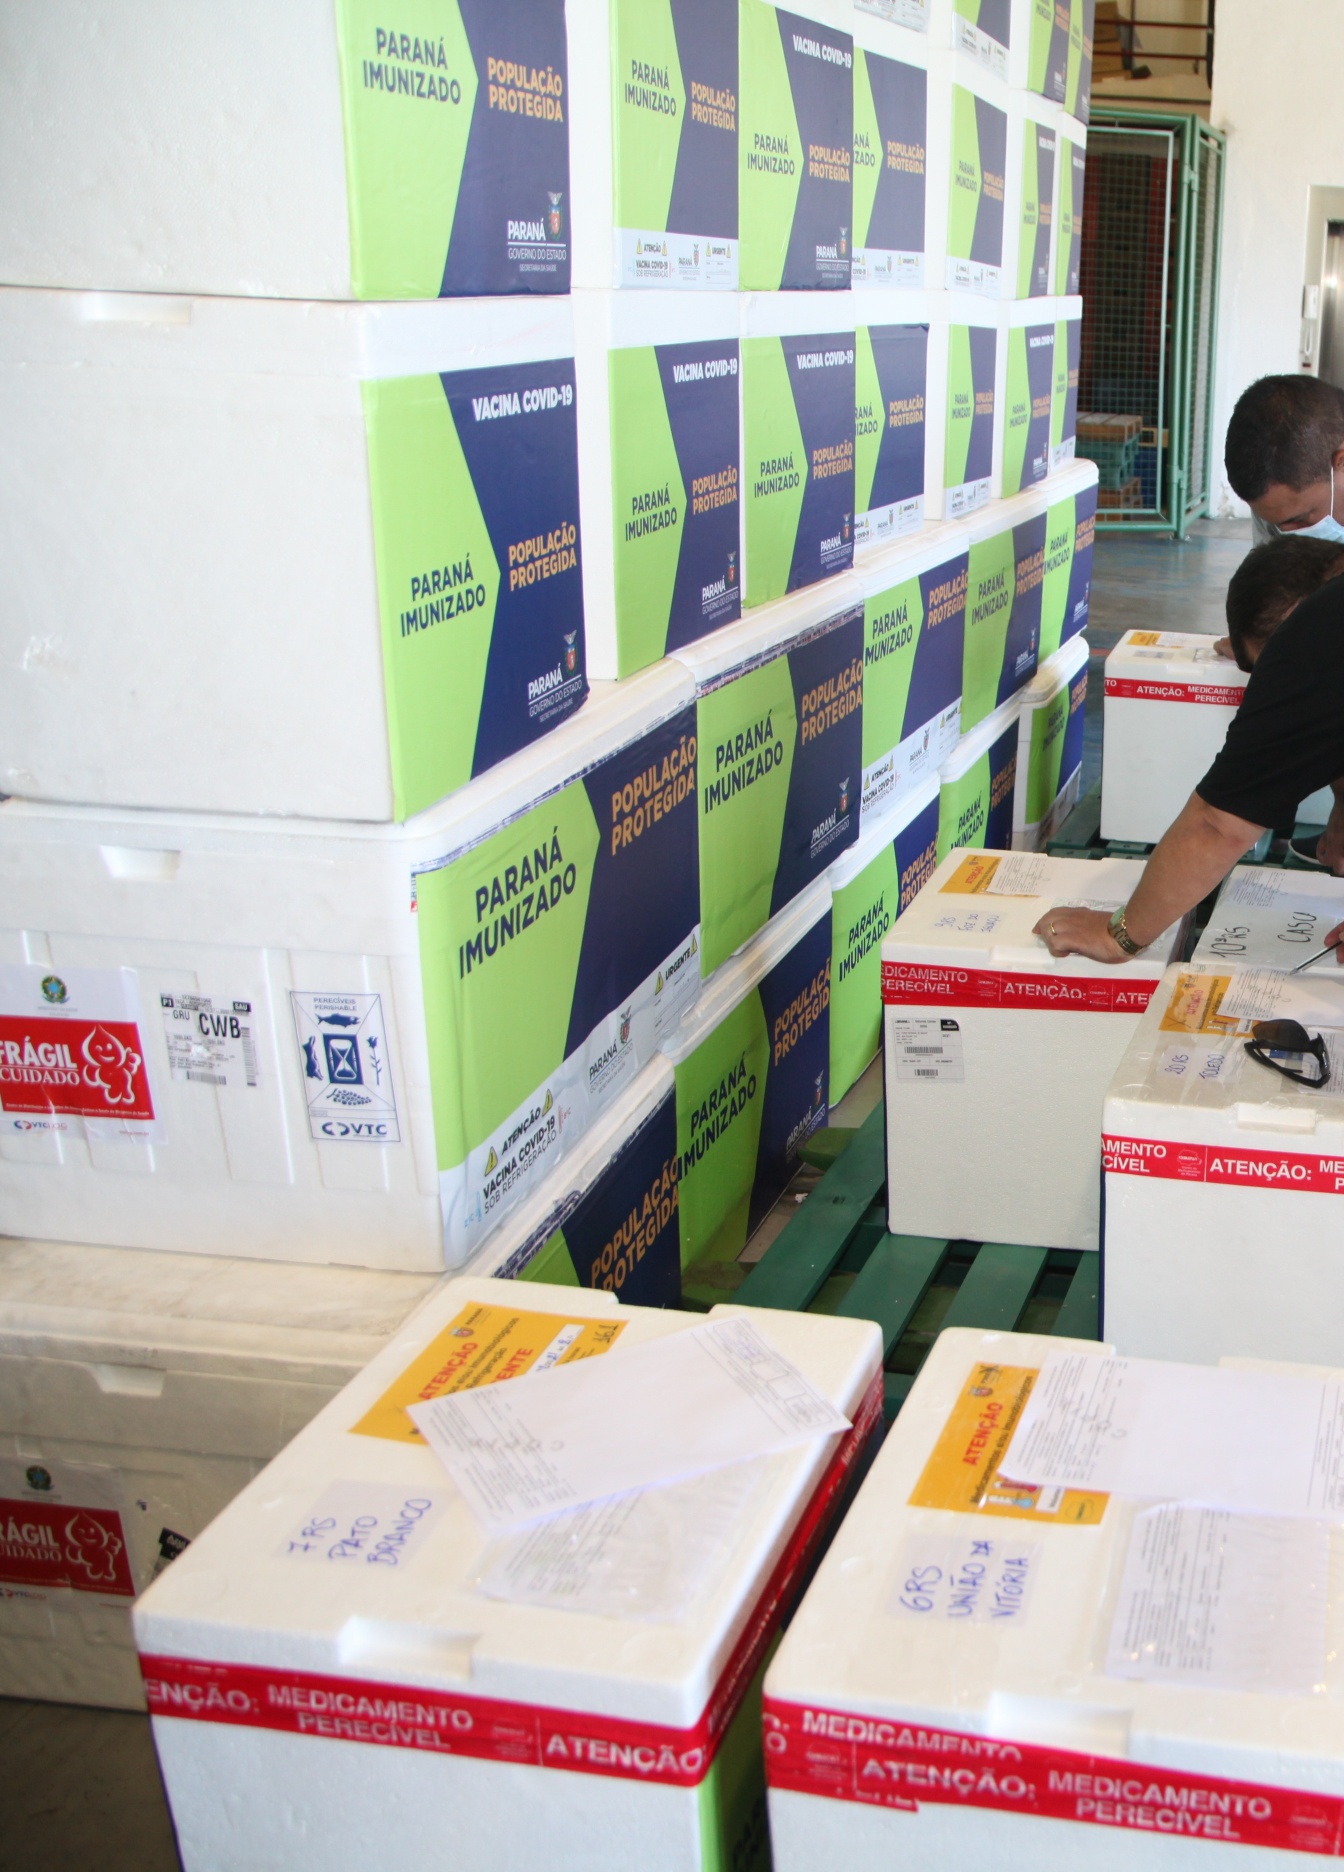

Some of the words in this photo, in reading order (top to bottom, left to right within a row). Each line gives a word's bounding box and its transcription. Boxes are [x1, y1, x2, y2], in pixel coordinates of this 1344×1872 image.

[376, 27, 448, 69] PARANÁ
[793, 34, 821, 59] VACINA
[822, 44, 851, 68] COVID-19
[363, 60, 461, 104] IMUNIZADO
[488, 57, 562, 98] POPULAÇÃO
[632, 59, 670, 91] PARANÁ
[489, 84, 563, 122] PROTEGIDA
[625, 83, 676, 116] IMUNIZADO
[691, 82, 736, 113] POPULAÇÃO
[692, 102, 736, 132] PROTEGIDA
[754, 134, 789, 155] PARANÁ
[809, 143, 850, 167] POPULAÇÃO
[888, 139, 925, 160] POPULAÇÃO
[748, 152, 794, 176] IMUNIZADO
[809, 163, 850, 182] PROTEGIDA
[888, 156, 924, 174] PROTEGIDA
[959, 160, 975, 177] PARANÁ
[507, 217, 545, 241] PARANÁ
[508, 248, 537, 261] GOVERNO
[538, 248, 545, 260] DO
[546, 248, 567, 261] ESTADO
[816, 243, 838, 259] PARANÁ
[673, 363, 703, 383] VACINA
[705, 358, 738, 379] COVID-19
[797, 352, 823, 369] VACINA
[825, 350, 853, 366] COVID-19
[472, 389, 521, 421] VACINA
[523, 385, 573, 413] COVID-19
[890, 395, 923, 413] POPULAÇÃO
[890, 414, 923, 428] PROTEGIDA
[760, 452, 794, 475] PARANÁ
[813, 442, 852, 464] POPULAÇÃO
[813, 458, 853, 480] PROTEGIDA
[692, 465, 737, 497] POPULAÇÃO
[754, 475, 800, 498] IMUNIZADO
[632, 483, 670, 516] PARANÁ
[693, 486, 738, 515] PROTEGIDA
[625, 507, 677, 542] IMUNIZADO
[509, 523, 576, 566] POPULAÇÃO
[821, 535, 841, 552] PARANÁ
[411, 553, 474, 601] PARANÁ
[510, 546, 577, 591] PROTEGIDA
[979, 567, 1005, 600] PARANÁ
[702, 577, 726, 600] PARANÁ
[400, 584, 486, 637] IMUNIZADO
[873, 599, 907, 639] PARANÁ
[972, 590, 1008, 626] IMUNIZADO
[865, 625, 912, 666] MUNIZADO
[528, 663, 563, 699] PARANÁ
[529, 696, 554, 717] GOVERNO
[554, 692, 562, 702] DO
[563, 680, 582, 698] ESTADO
[802, 658, 862, 718] POPULAÇÃO
[1137, 686, 1184, 697] ATENÇÃO:
[802, 685, 862, 745] PROTEGIDA
[1195, 695, 1240, 704] PERECÍVEL
[716, 709, 773, 772] PARANÁ
[612, 736, 696, 822] POPULAÇÃO
[705, 741, 783, 814] IMUNIZADO
[612, 766, 695, 856] PROTEGIDA
[811, 809, 836, 842] PARANÁ
[958, 791, 982, 833] PARANÁ
[476, 826, 562, 923] PARANÁ
[458, 862, 577, 980] IMUNIZADO
[848, 891, 884, 949] PARANÁ
[666, 947, 690, 980] URGENTE
[839, 913, 889, 982] IMUNIZADO
[1004, 983, 1086, 1000] ATENÇÃO:
[173, 1010, 190, 1020] GRU
[199, 1013, 241, 1038] CWB
[0, 1068, 80, 1085] CUIDADO
[589, 1039, 617, 1080] PARANÁ
[1199, 1054, 1225, 1079] TOLEDO
[691, 1051, 746, 1138] PARANÁ
[350, 1123, 387, 1135] VTC
[502, 1107, 540, 1155] ATENÇÃO
[677, 1074, 756, 1181] IMUNIZADO
[787, 1105, 811, 1150] PARANÁ
[483, 1157, 517, 1199] VACINA
[519, 1115, 555, 1161] COVID-19
[484, 1192, 500, 1214] SOB
[502, 1130, 556, 1194] REFRIGERAÇÃO
[1210, 1158, 1312, 1181] ATENÇÃO:
[591, 1155, 678, 1289] POPULAÇÃO
[418, 1342, 479, 1399] ATENÇÃO
[963, 1402, 1003, 1466] ATENÇÃO
[328, 1516, 377, 1559] PATO
[367, 1499, 432, 1565] BRANCO
[947, 1563, 985, 1617] UNIÃO
[989, 1558, 1029, 1618] VITÓRIA
[267, 1683, 473, 1731] MEDICAMENTO
[297, 1710, 450, 1749] PERECÍVEL
[862, 1757, 1036, 1800] ATENÇÃO:
[1047, 1769, 1271, 1819] MEDICAMENTO
[1075, 1799, 1240, 1839] PERECÍVEL
